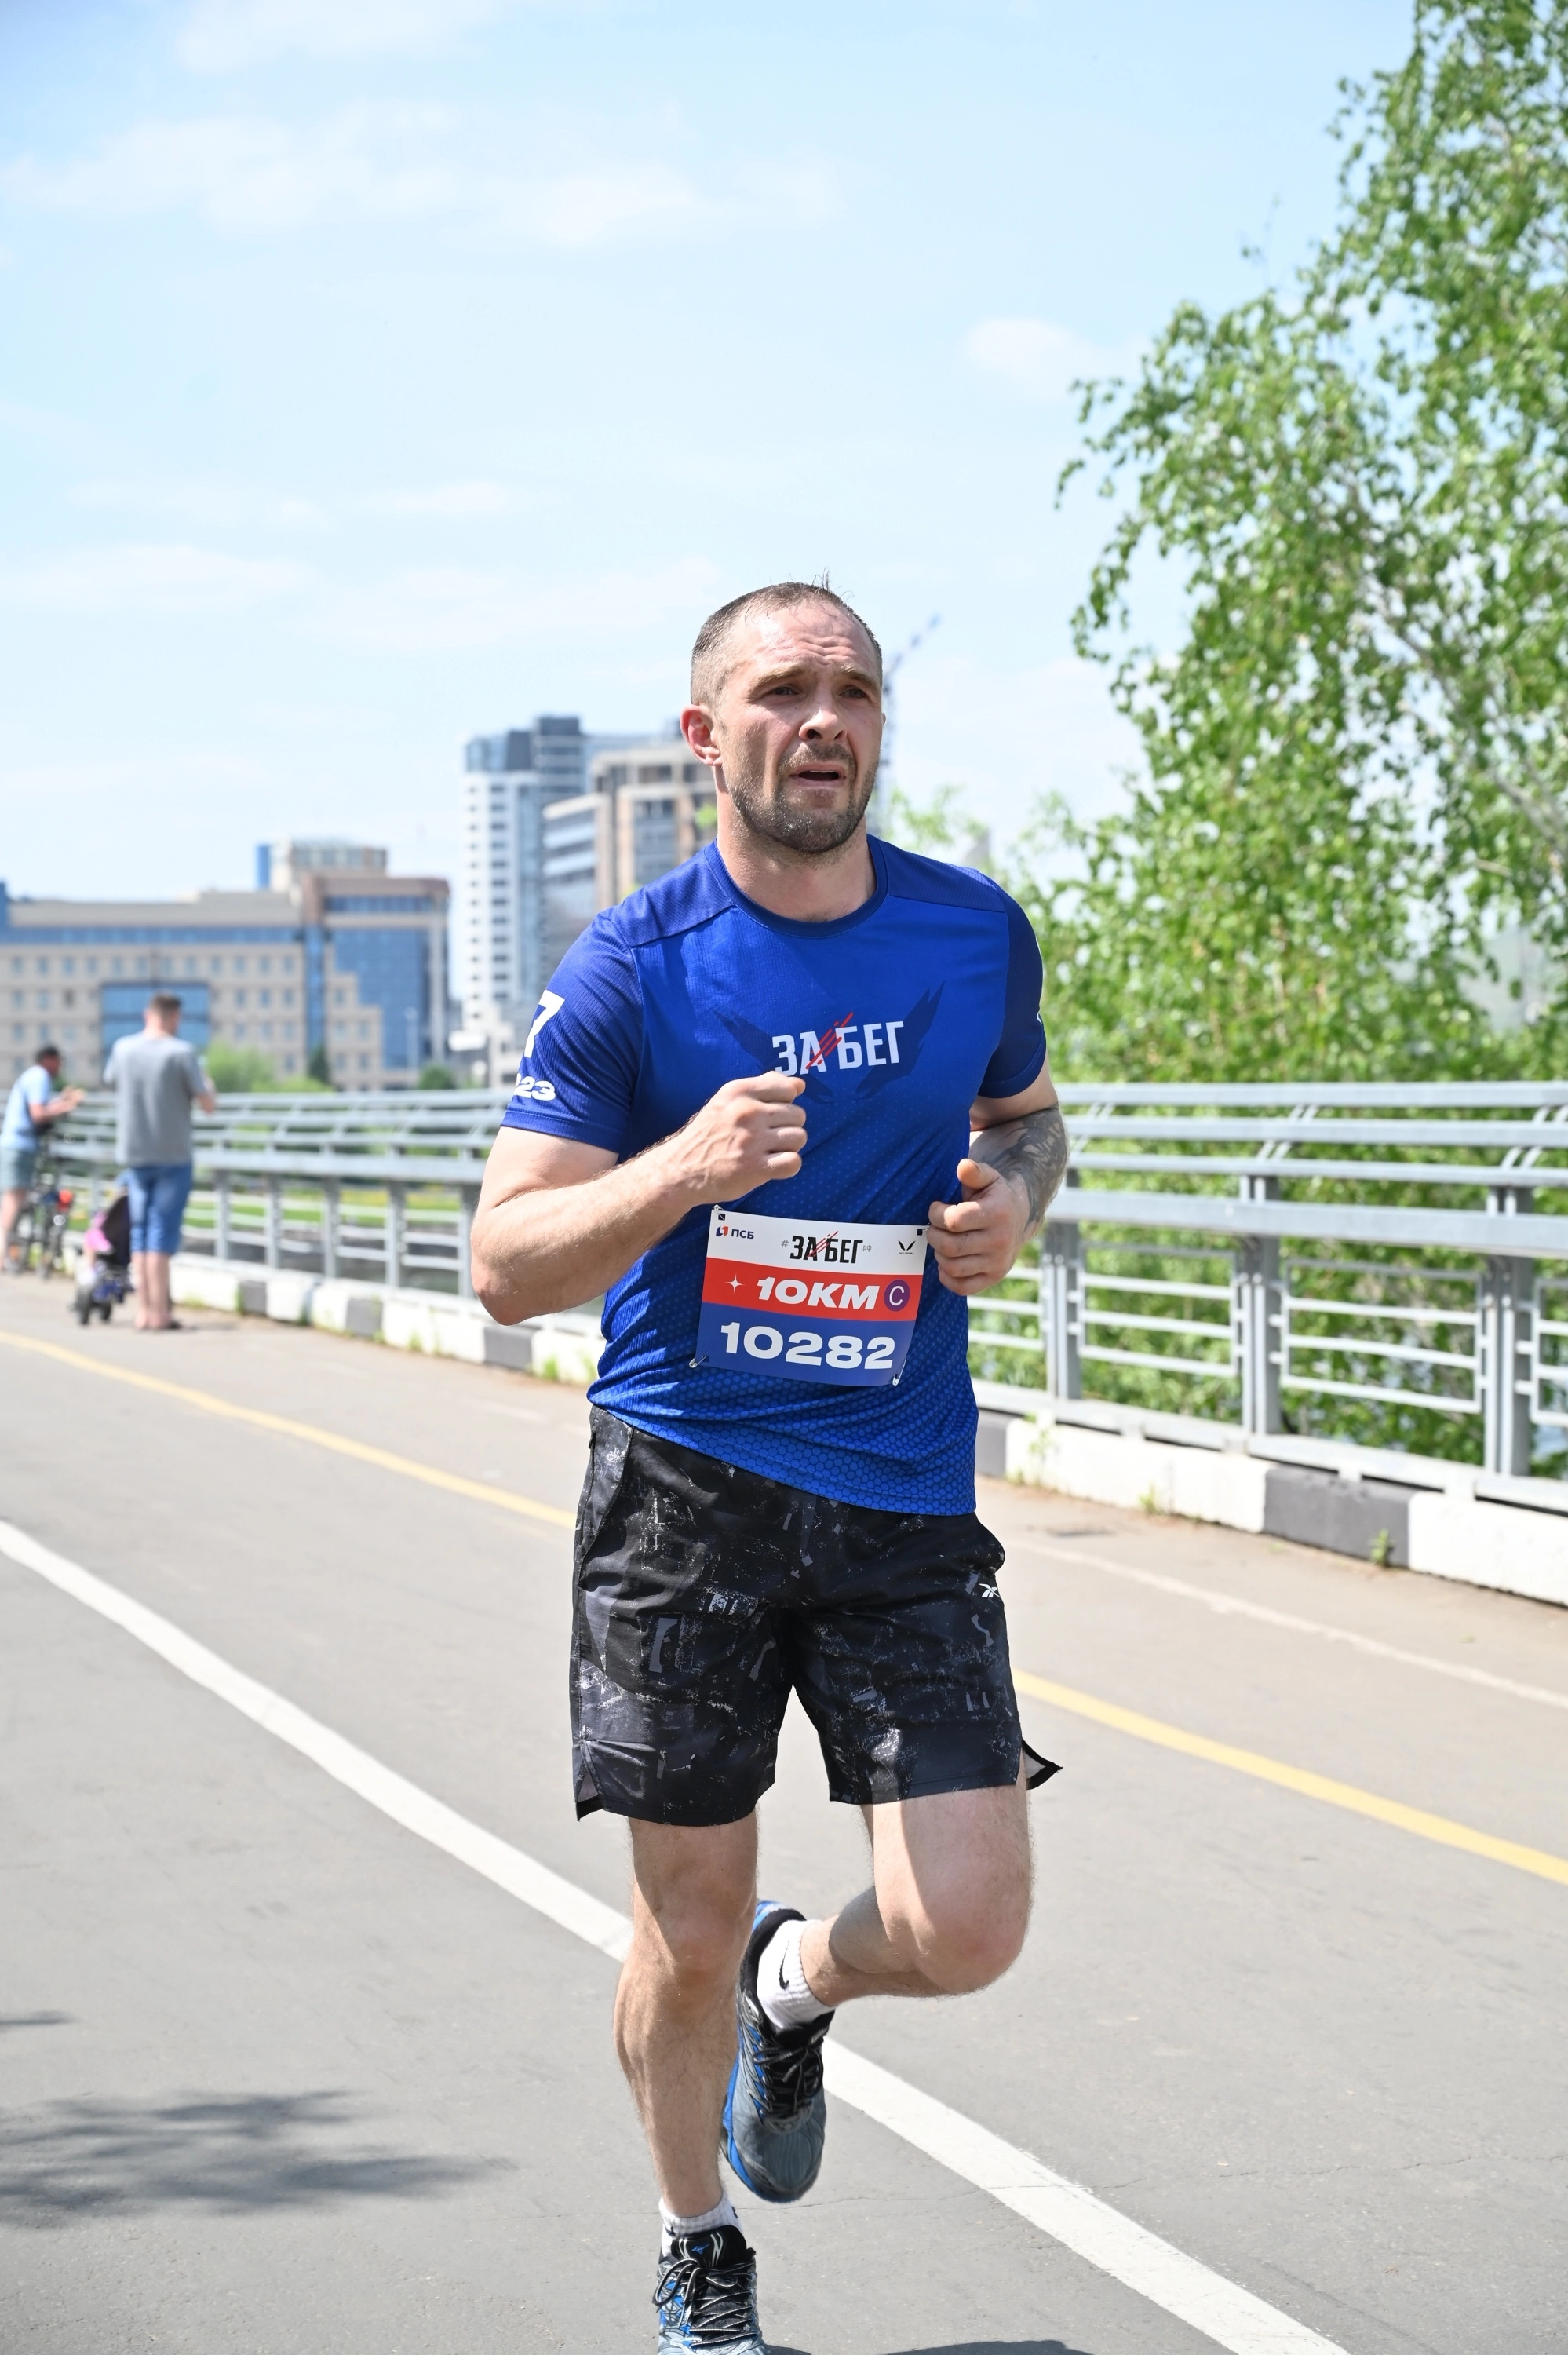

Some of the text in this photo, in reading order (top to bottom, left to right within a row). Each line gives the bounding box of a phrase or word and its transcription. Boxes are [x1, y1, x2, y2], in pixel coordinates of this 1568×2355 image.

[771, 1020, 904, 1077] ЗАБЕГ
[513, 1073, 556, 1101] 23
[731, 1228, 755, 1240] ПСБ
[720, 1321, 895, 1370] 10282
